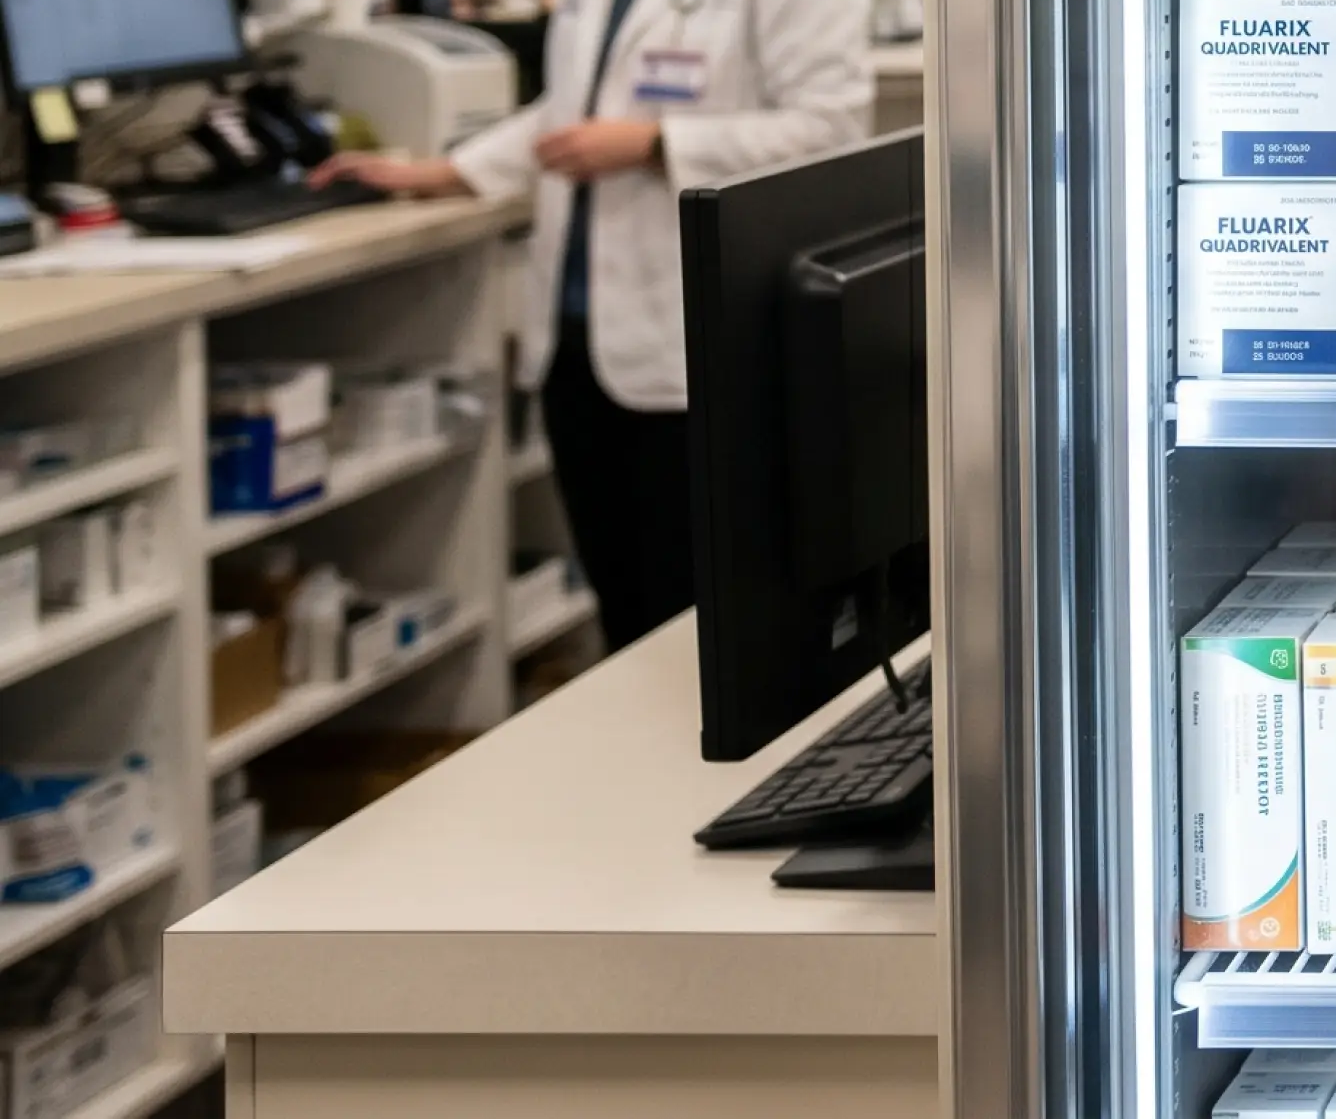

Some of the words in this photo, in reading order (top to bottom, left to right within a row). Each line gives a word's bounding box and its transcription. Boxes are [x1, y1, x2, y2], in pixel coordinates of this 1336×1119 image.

[1219, 19, 1311, 37] FLUARIX
[1200, 41, 1330, 56] QUADRIVALENT
[1218, 216, 1311, 234] FLUARIX
[1200, 238, 1329, 254] QUADRIVALENT
